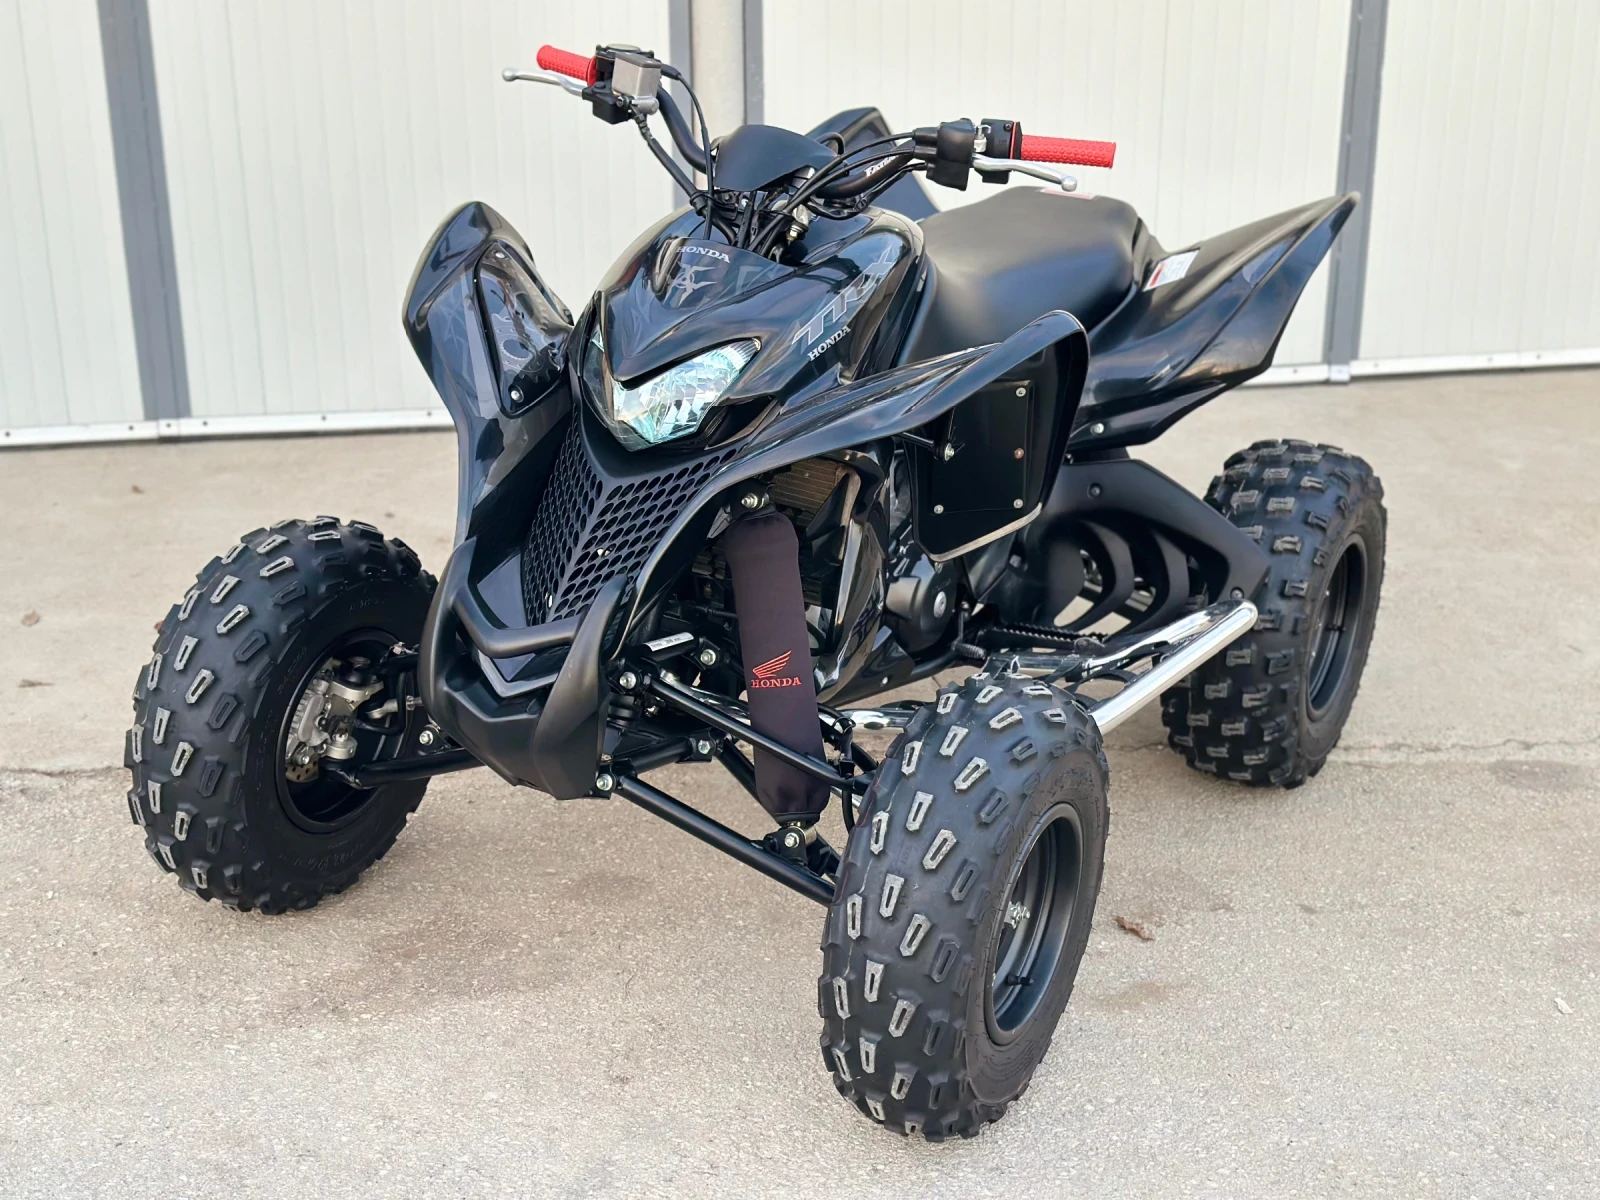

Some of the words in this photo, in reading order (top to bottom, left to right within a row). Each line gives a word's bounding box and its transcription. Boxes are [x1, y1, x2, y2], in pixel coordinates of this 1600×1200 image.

[676, 245, 731, 264] HONDA
[807, 325, 852, 361] HONDA
[751, 676, 802, 688] HONDA
